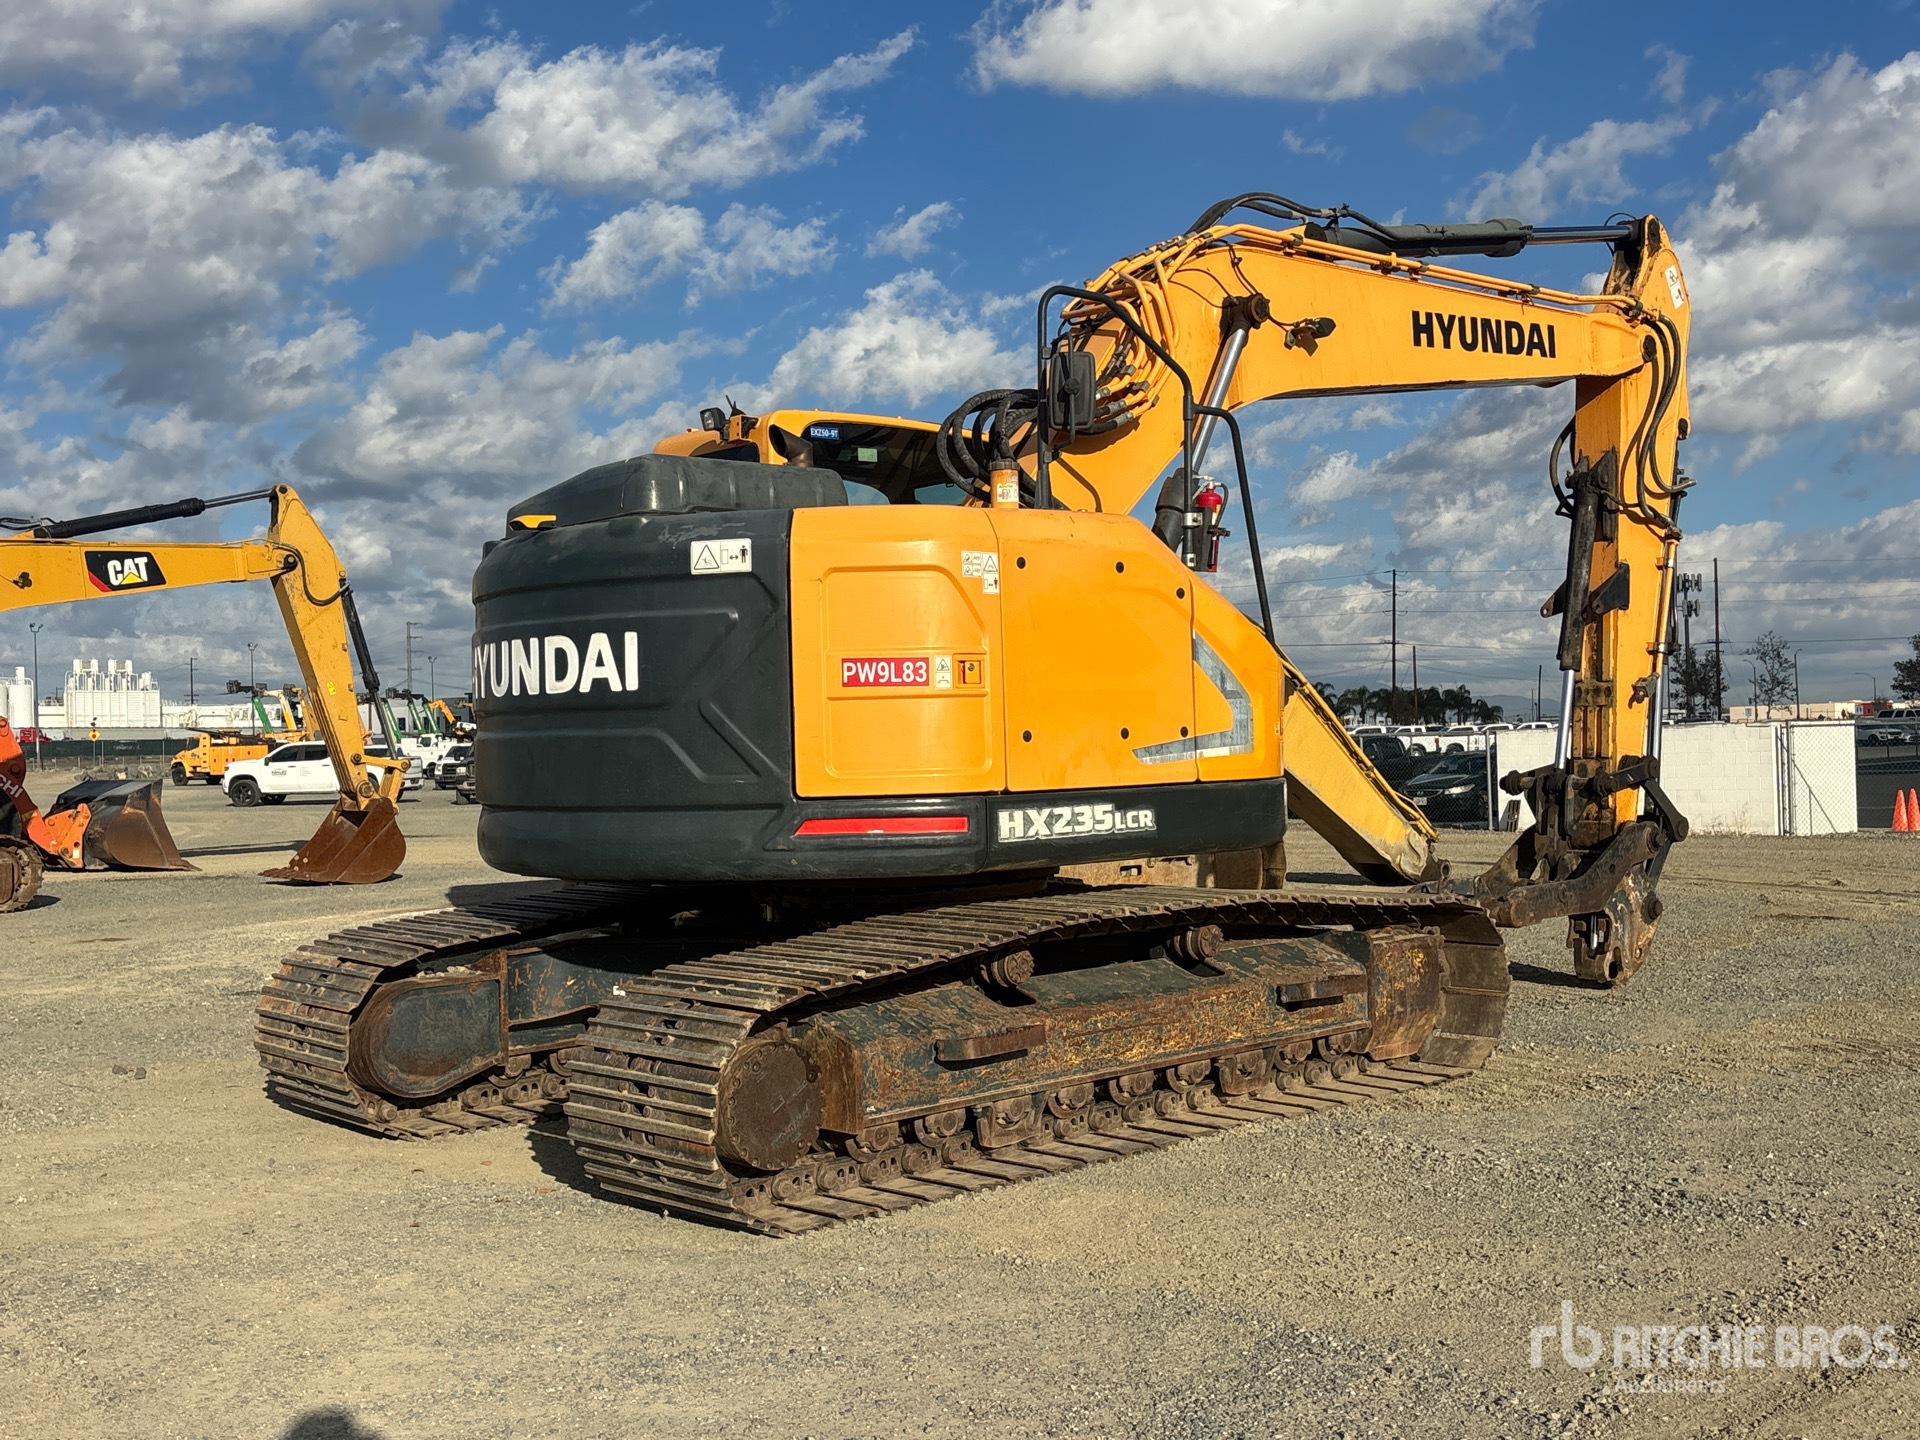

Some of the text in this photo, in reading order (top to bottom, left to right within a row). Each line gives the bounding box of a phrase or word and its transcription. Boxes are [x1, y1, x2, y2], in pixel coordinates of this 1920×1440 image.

[1411, 310, 1557, 359] HYUNDAI
[107, 556, 148, 586] CAT
[843, 661, 928, 683] PW9L83
